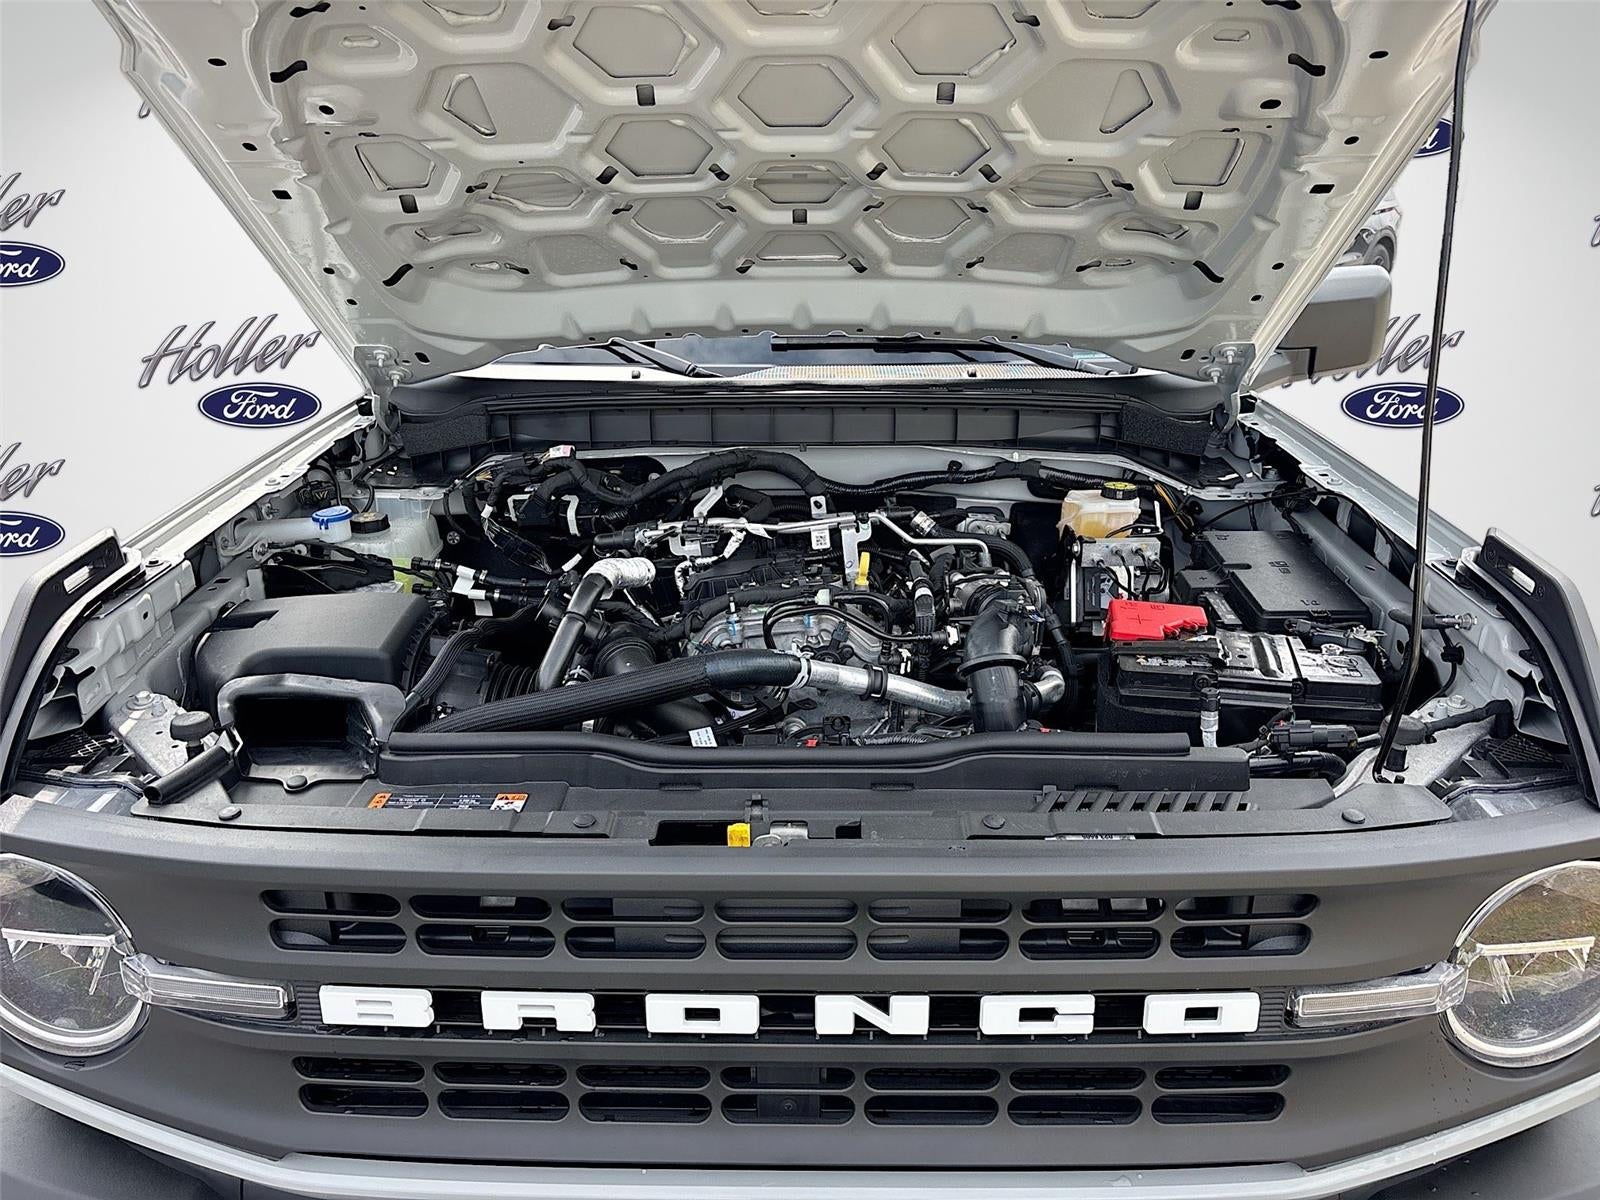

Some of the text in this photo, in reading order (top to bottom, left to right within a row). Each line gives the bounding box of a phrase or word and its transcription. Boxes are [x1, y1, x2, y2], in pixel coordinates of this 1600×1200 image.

[138, 313, 322, 388] Holler
[223, 389, 297, 419] Ford
[319, 984, 1260, 1035] BRONCO
